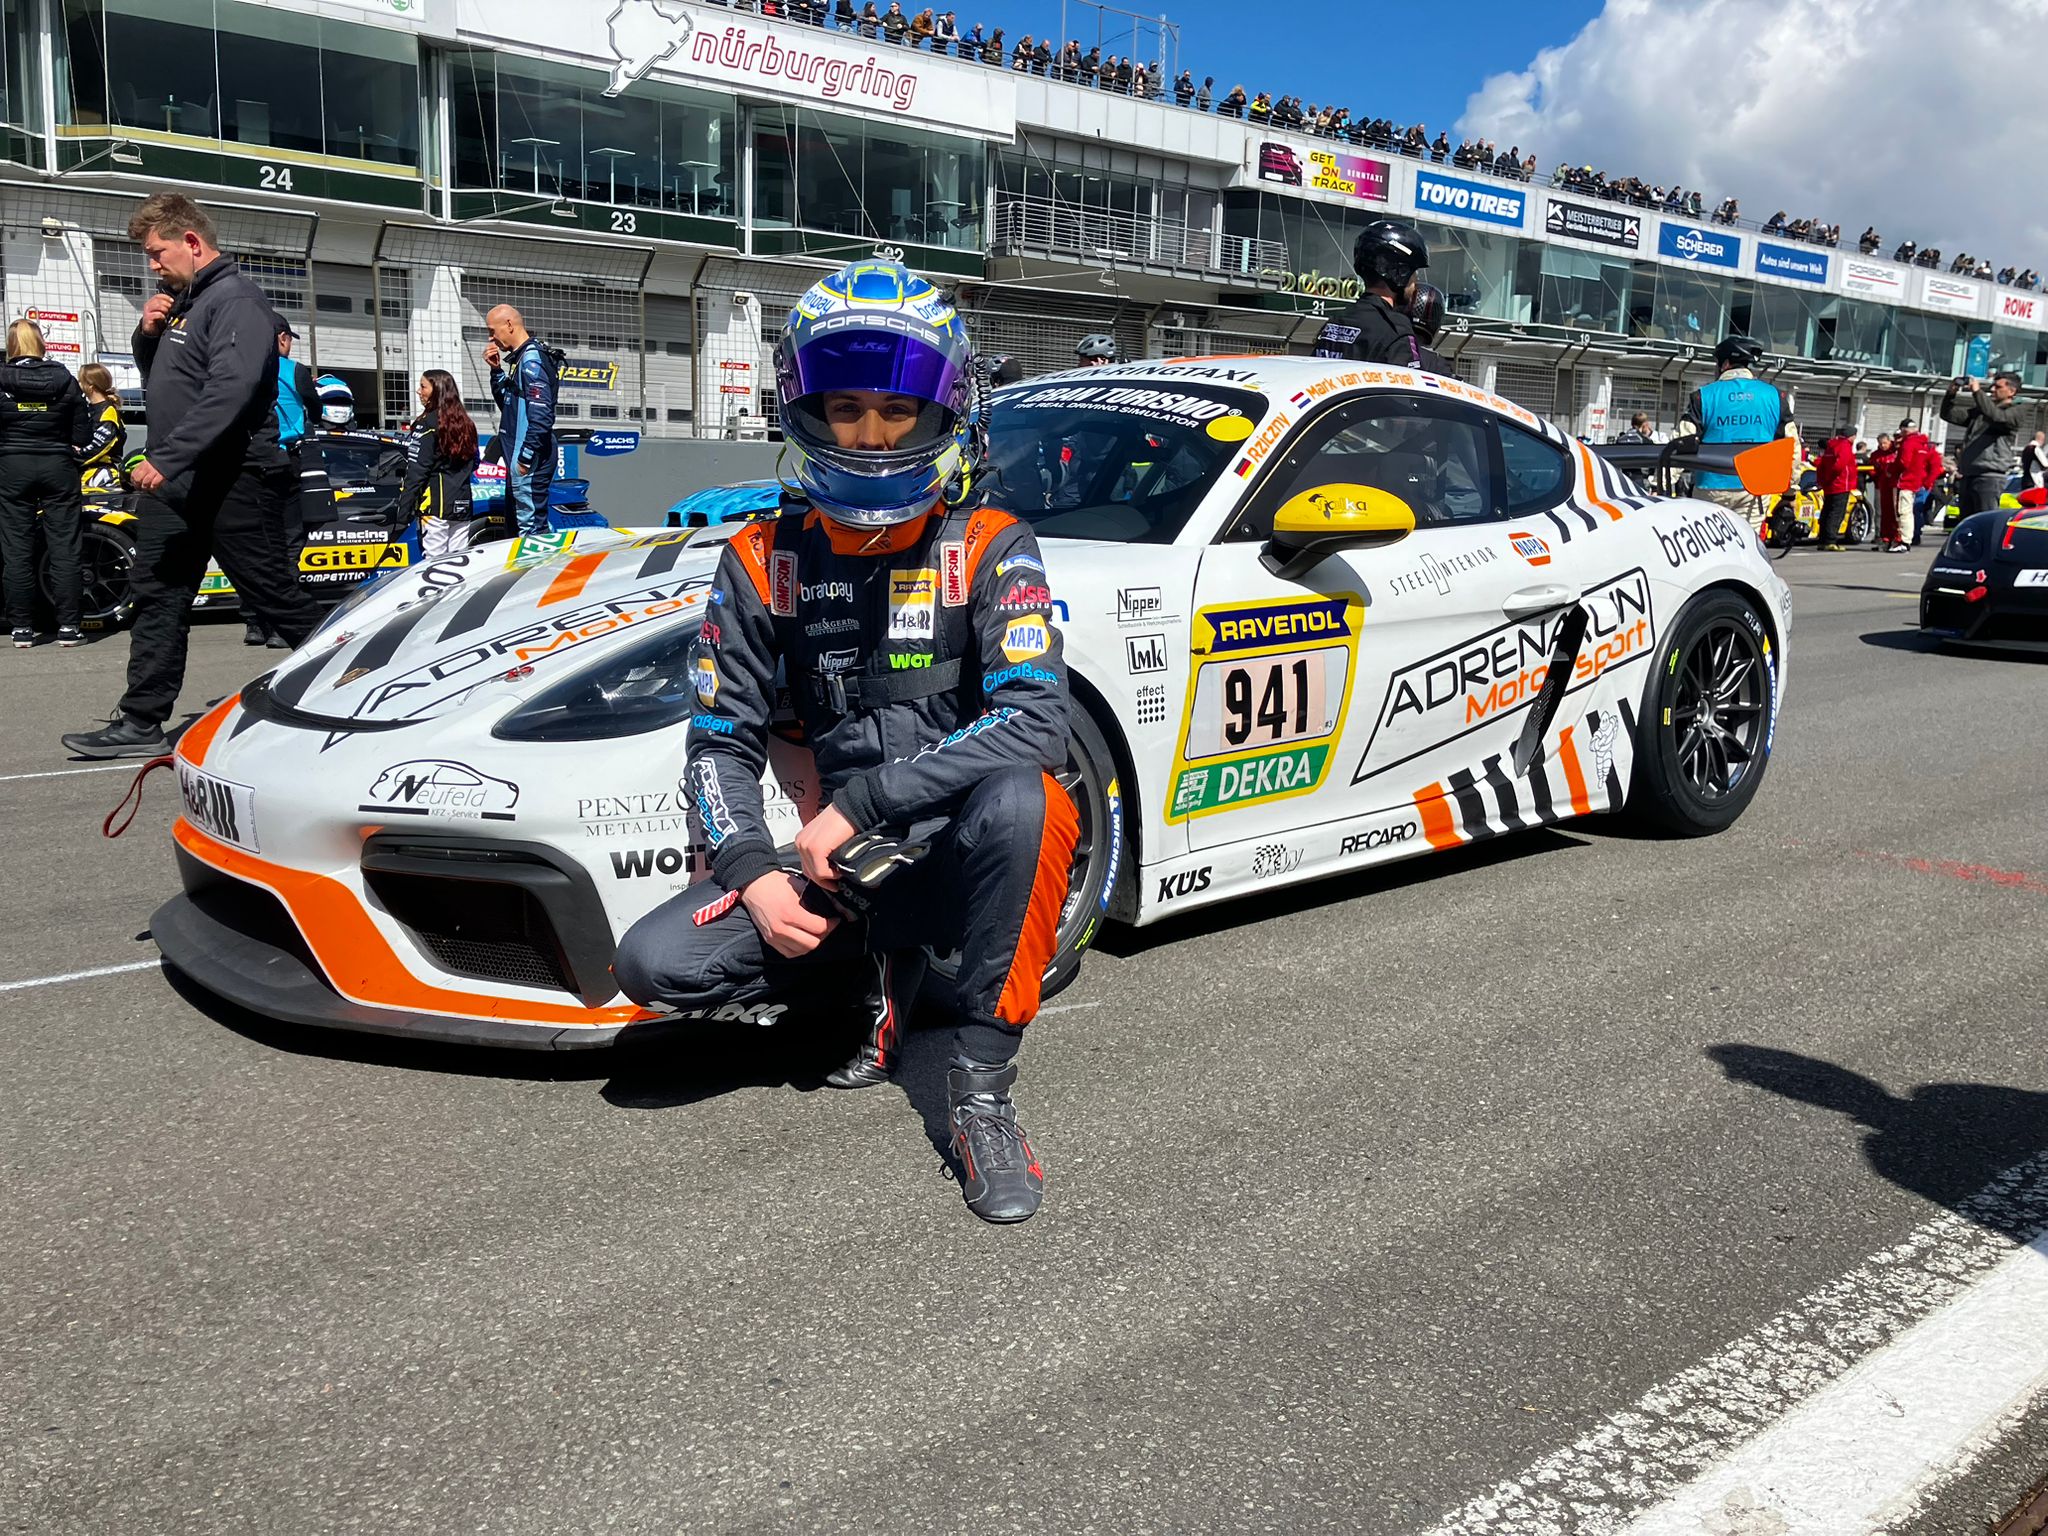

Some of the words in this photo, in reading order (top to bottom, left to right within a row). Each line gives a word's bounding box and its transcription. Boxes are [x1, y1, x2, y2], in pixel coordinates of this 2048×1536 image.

[692, 27, 917, 109] nürburgring
[1310, 152, 1334, 165] GET
[260, 165, 293, 191] 24
[1314, 176, 1354, 192] TRACK
[1321, 167, 1339, 178] ON
[1421, 181, 1469, 208] TOYO
[1470, 191, 1521, 219] TIRES
[610, 211, 637, 234] 23
[1676, 236, 1724, 257] SCHERER
[1760, 254, 1778, 265] Autos
[1778, 257, 1790, 269] sind
[39, 312, 68, 320] CAUTION
[1312, 301, 1326, 316] 21
[2004, 297, 2034, 319] ROWE
[810, 315, 940, 346] PORSCHE
[45, 343, 73, 351] CHTUNG
[1023, 387, 1101, 404] GRAN
[1306, 380, 1336, 400] Mark
[1337, 373, 1362, 388] van
[1364, 371, 1383, 384] der
[1389, 371, 1414, 385] Snel
[1439, 379, 1463, 394] Max
[1468, 388, 1488, 402] van
[1037, 401, 1064, 409] REAL
[1068, 402, 1118, 412] DRIVING
[1120, 406, 1200, 429] SIMULATOR
[1717, 414, 1763, 426] MEDIA
[1247, 411, 1292, 464] Rziczny
[308, 530, 334, 541] WS
[337, 529, 389, 543] Racing
[1515, 538, 1545, 559] NAPA
[1652, 509, 1747, 568] brainpay
[305, 549, 367, 567] Giti
[777, 558, 791, 611] SIMPSON
[948, 549, 960, 601] SIMPSON
[1390, 571, 1431, 597] STEEL
[1432, 546, 1498, 582] INTERIOR
[800, 579, 853, 603] brainpay
[1117, 588, 1160, 622] Nipper
[1007, 627, 1044, 650] NAPA
[1221, 609, 1341, 642] RAVENOL
[368, 579, 713, 713] ADRENA
[819, 652, 855, 673] Nipper
[1465, 619, 1649, 725] Motosport
[983, 662, 1058, 693] Claaßen
[1136, 685, 1165, 698] effect
[1224, 659, 1308, 746] 941
[1218, 752, 1312, 802] DEKRA
[387, 775, 488, 807] Neufeld
[431, 809, 446, 817] KFZ
[451, 809, 479, 819] Service
[577, 792, 671, 819] PENTZ
[1339, 821, 1418, 857] RECARO
[1103, 813, 1121, 903] MICHELIN
[1158, 866, 1212, 903] KÜS
